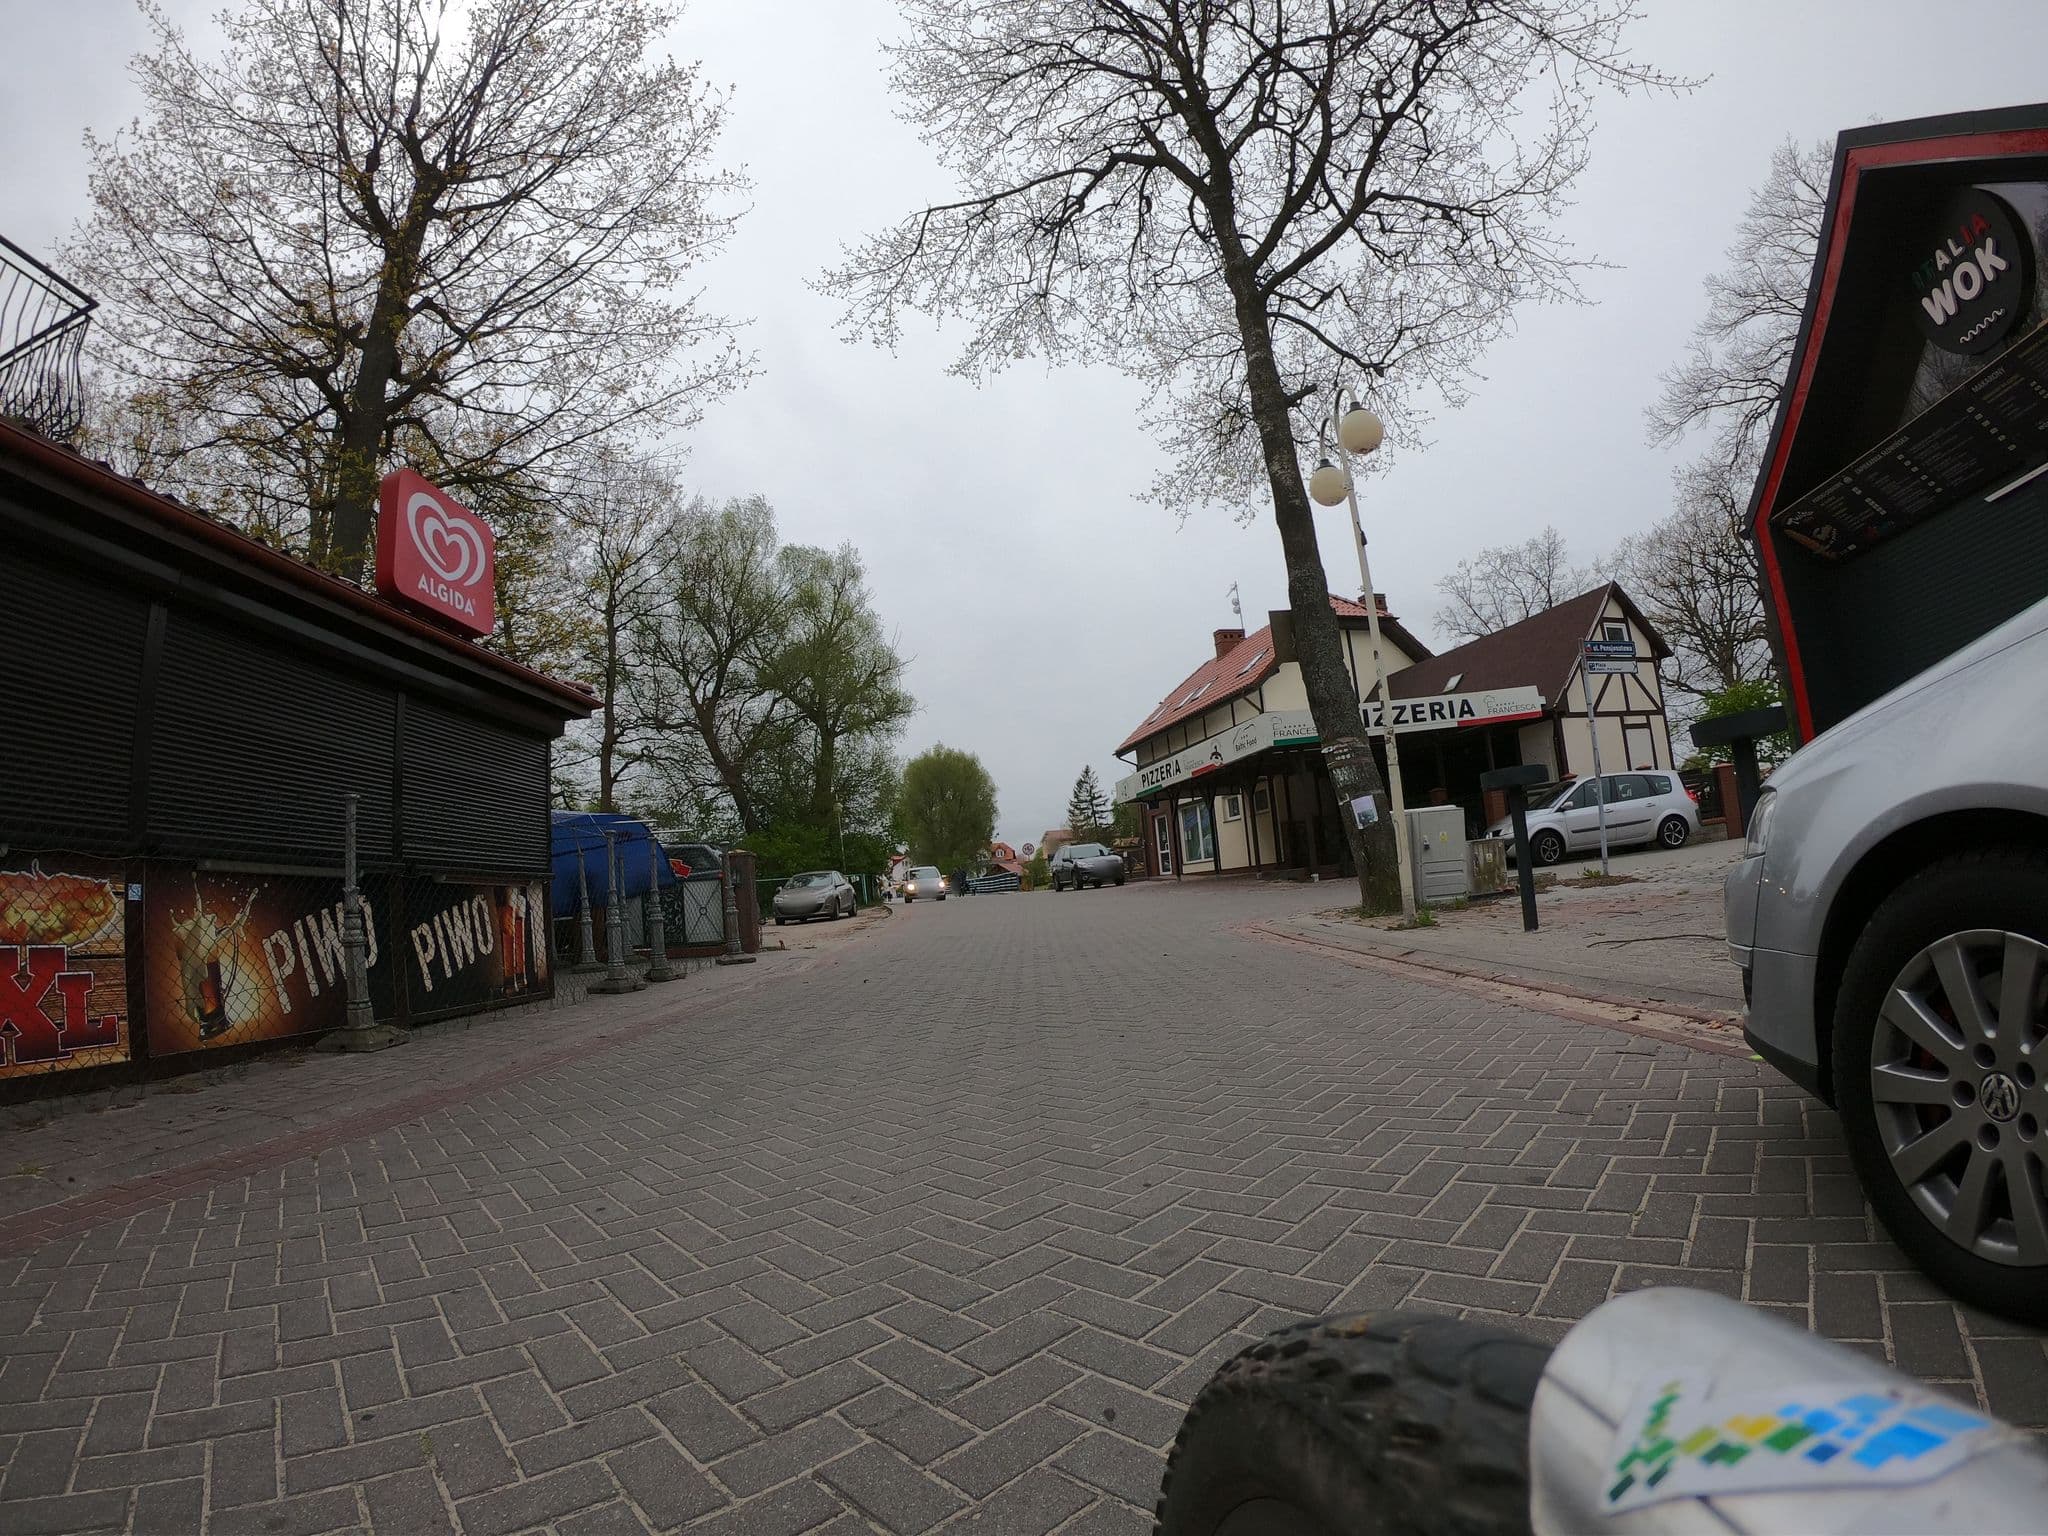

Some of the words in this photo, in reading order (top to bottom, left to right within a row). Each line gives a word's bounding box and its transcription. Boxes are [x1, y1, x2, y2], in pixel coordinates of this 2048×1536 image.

[1922, 237, 2008, 325] WOK
[418, 573, 474, 616] ALGIDA
[1362, 698, 1475, 727] IZZERIA
[1487, 702, 1537, 715] FRANCESCA
[1273, 726, 1319, 738] FRANCES
[1141, 759, 1181, 788] PIZZERIA
[411, 894, 494, 992] PIWO
